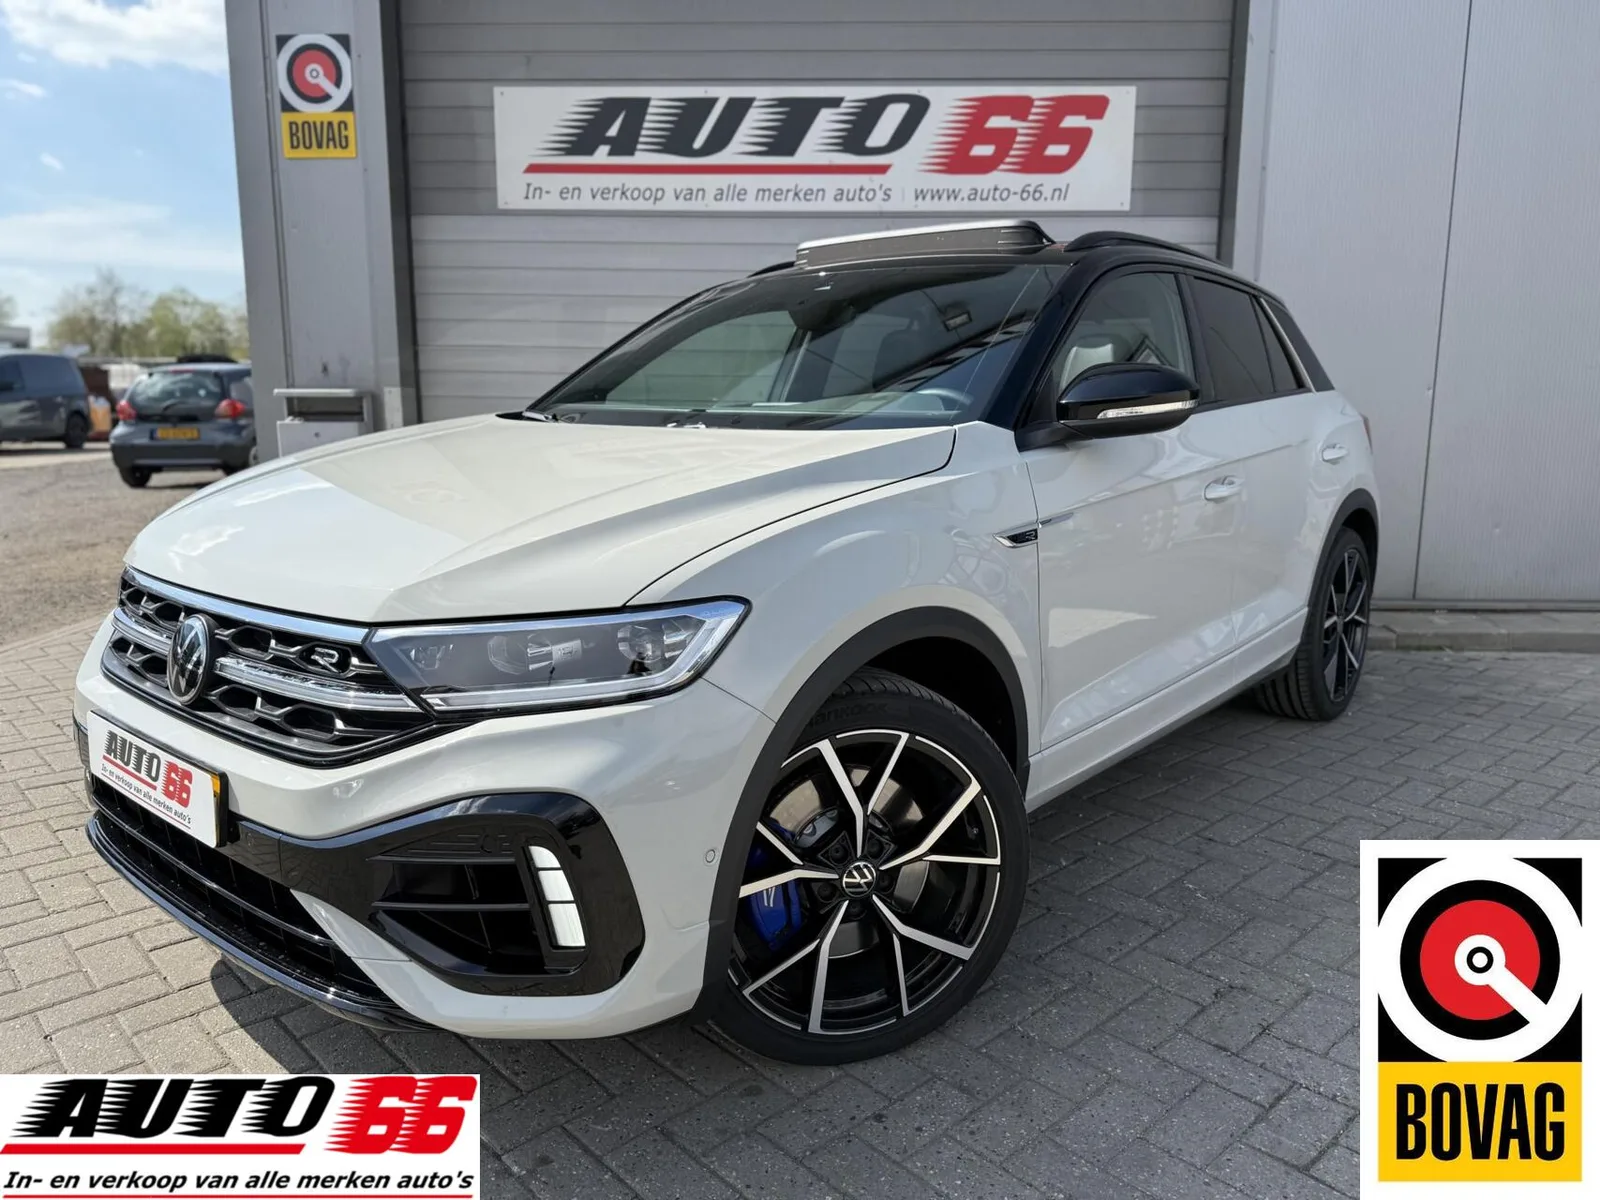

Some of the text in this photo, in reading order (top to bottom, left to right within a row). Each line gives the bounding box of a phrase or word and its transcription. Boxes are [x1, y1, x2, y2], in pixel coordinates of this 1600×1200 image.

[288, 120, 349, 150] BOVAG
[528, 93, 1111, 175] AUTO 66
[524, 183, 892, 205] In- en verkoop van alle merken auto's
[914, 183, 1070, 202] www.auto-66.nl
[104, 729, 193, 808] AUTO 66
[115, 773, 133, 790] verkoop
[133, 784, 142, 796] van
[142, 790, 153, 802] alle
[153, 796, 173, 814] merken
[173, 808, 191, 825] auto's
